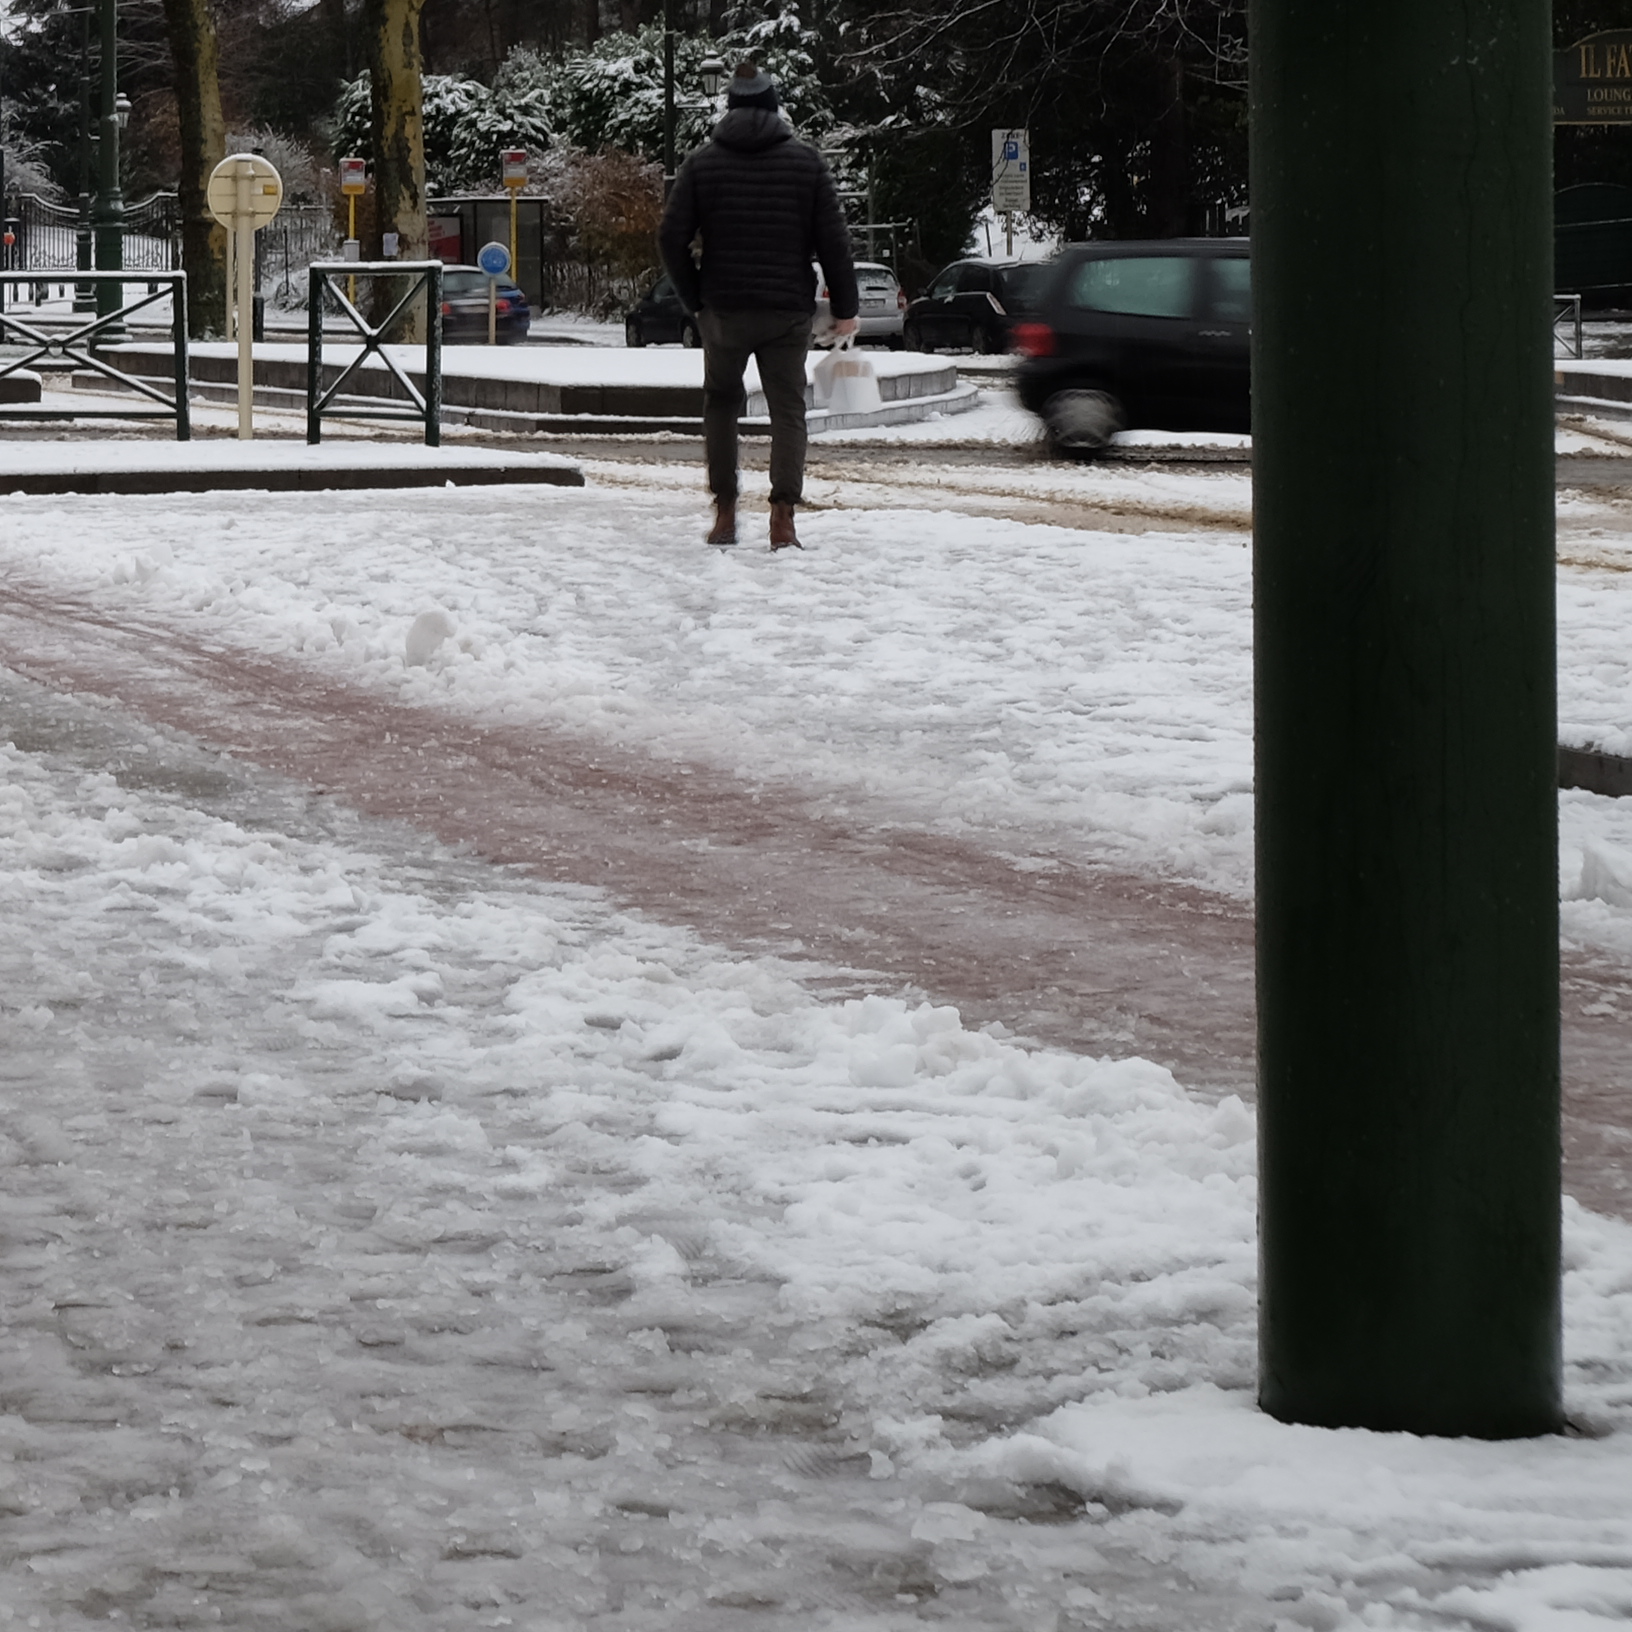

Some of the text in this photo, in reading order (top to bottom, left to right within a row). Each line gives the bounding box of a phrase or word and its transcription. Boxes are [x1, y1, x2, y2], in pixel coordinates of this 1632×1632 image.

[1579, 44, 1632, 78] IL FA
[1587, 88, 1632, 102] LOUNG
